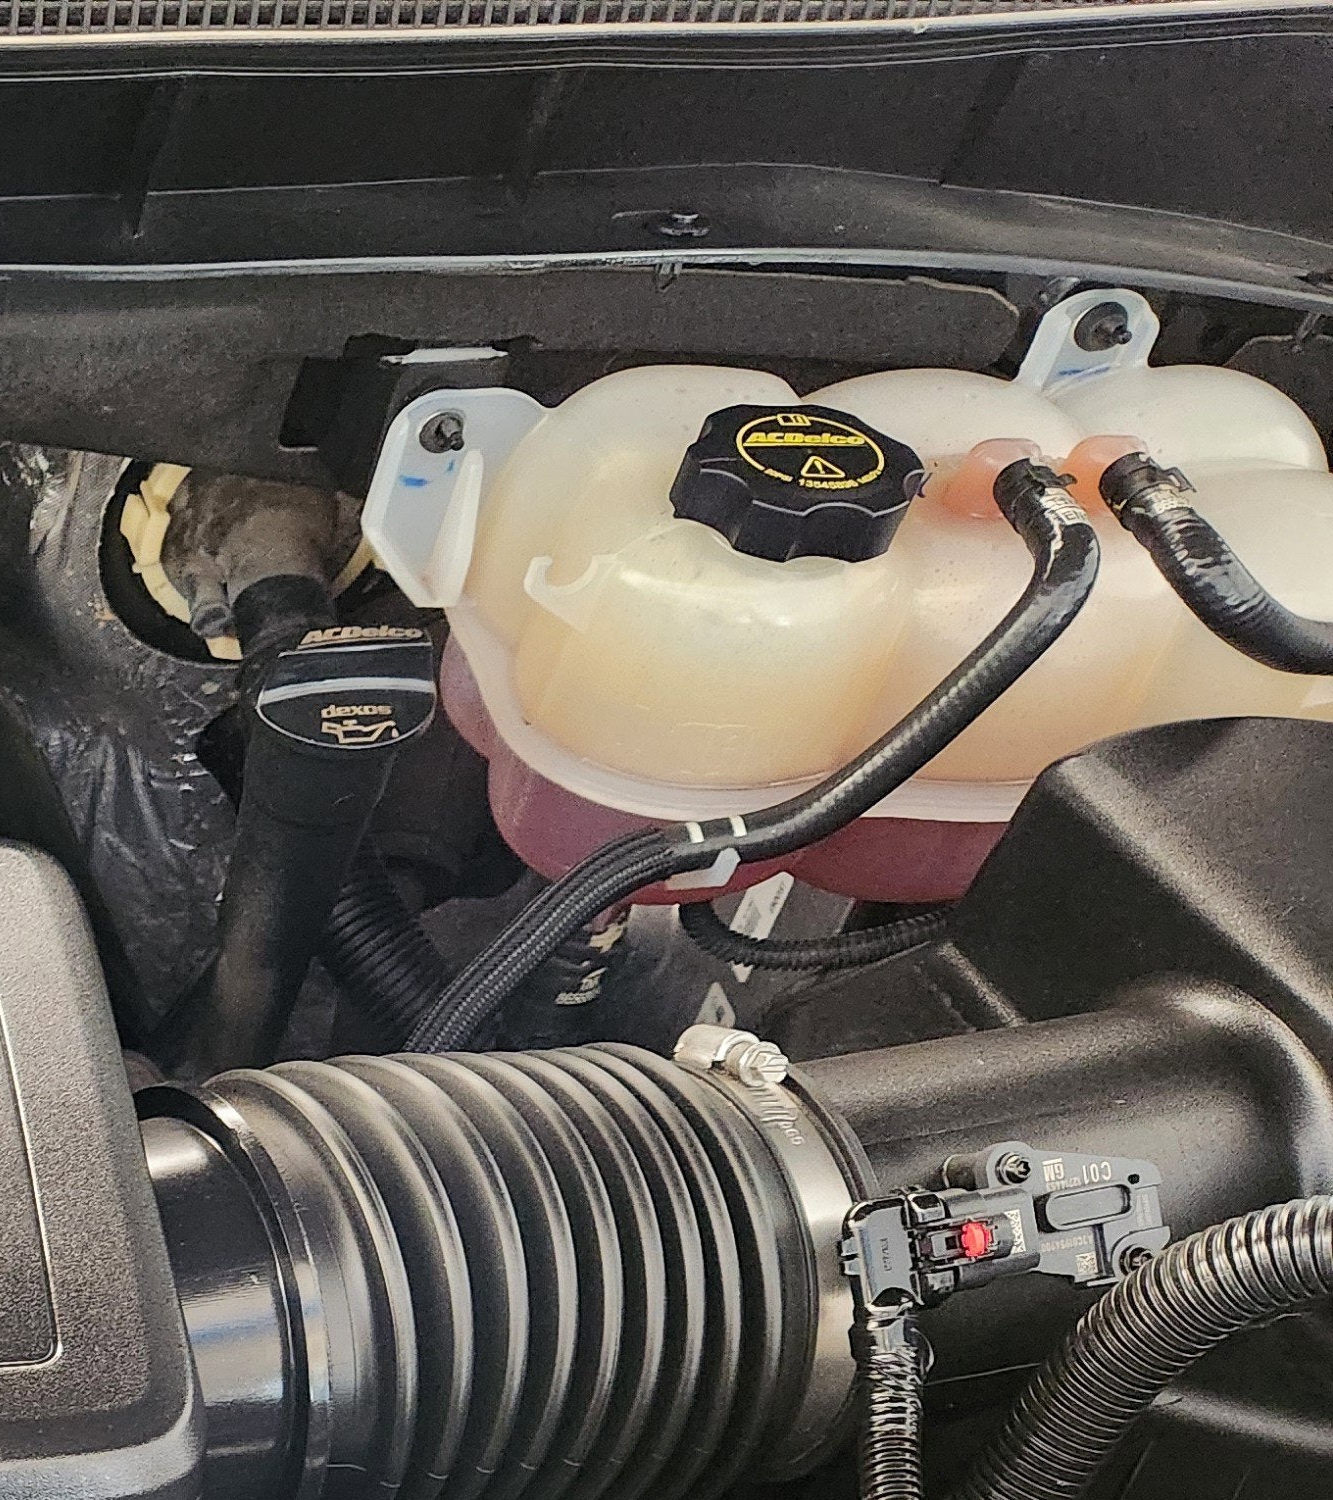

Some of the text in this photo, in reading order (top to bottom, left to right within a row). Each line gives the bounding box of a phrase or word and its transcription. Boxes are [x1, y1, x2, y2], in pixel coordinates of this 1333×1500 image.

[749, 431, 866, 445] ACDelco
[299, 624, 423, 645] ACDelco
[320, 703, 393, 719] dexos
[1042, 1162, 1065, 1182] GM
[1082, 1161, 1112, 1185] C01
